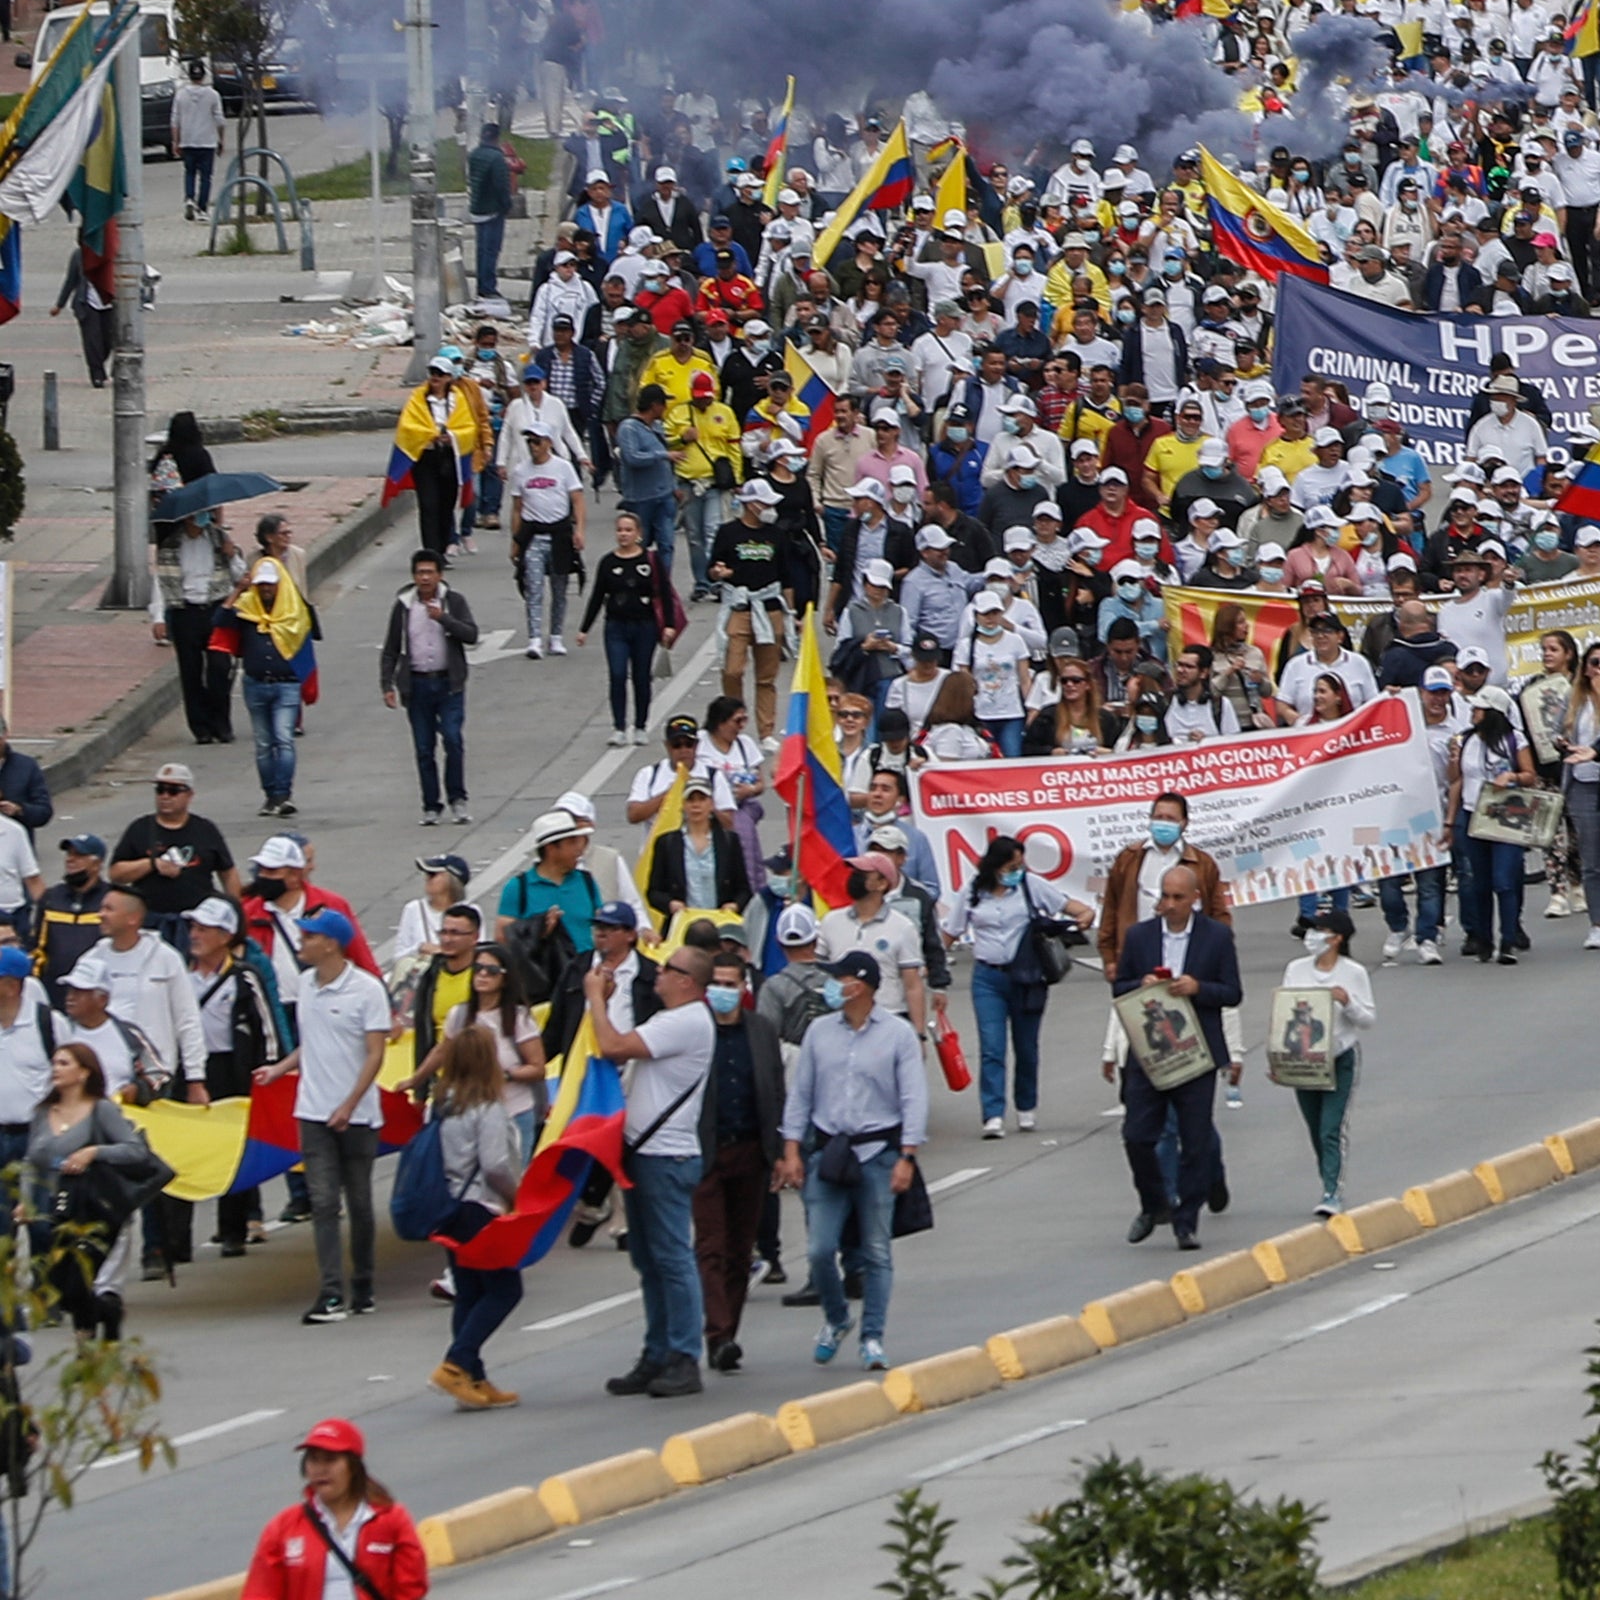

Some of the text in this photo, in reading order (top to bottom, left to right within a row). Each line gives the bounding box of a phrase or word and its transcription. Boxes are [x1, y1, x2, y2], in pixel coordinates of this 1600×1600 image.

[1308, 347, 1420, 394] CRIMINAL,
[1426, 366, 1560, 400] TERROTA
[1562, 376, 1579, 398] Y
[1349, 394, 1471, 429] PSIDENT
[1504, 607, 1534, 633] oral
[930, 790, 1030, 809] MILLONES
[1033, 788, 1061, 804] DE
[1064, 780, 1160, 801] RAZONES
[1161, 769, 1218, 793] PARA
[1219, 763, 1278, 782] SALIR
[1323, 725, 1402, 754] CALLE...
[1041, 744, 1295, 787] GRAN MARCHA NACIONAL
[1122, 809, 1150, 821] refo
[945, 823, 1073, 893] NO
